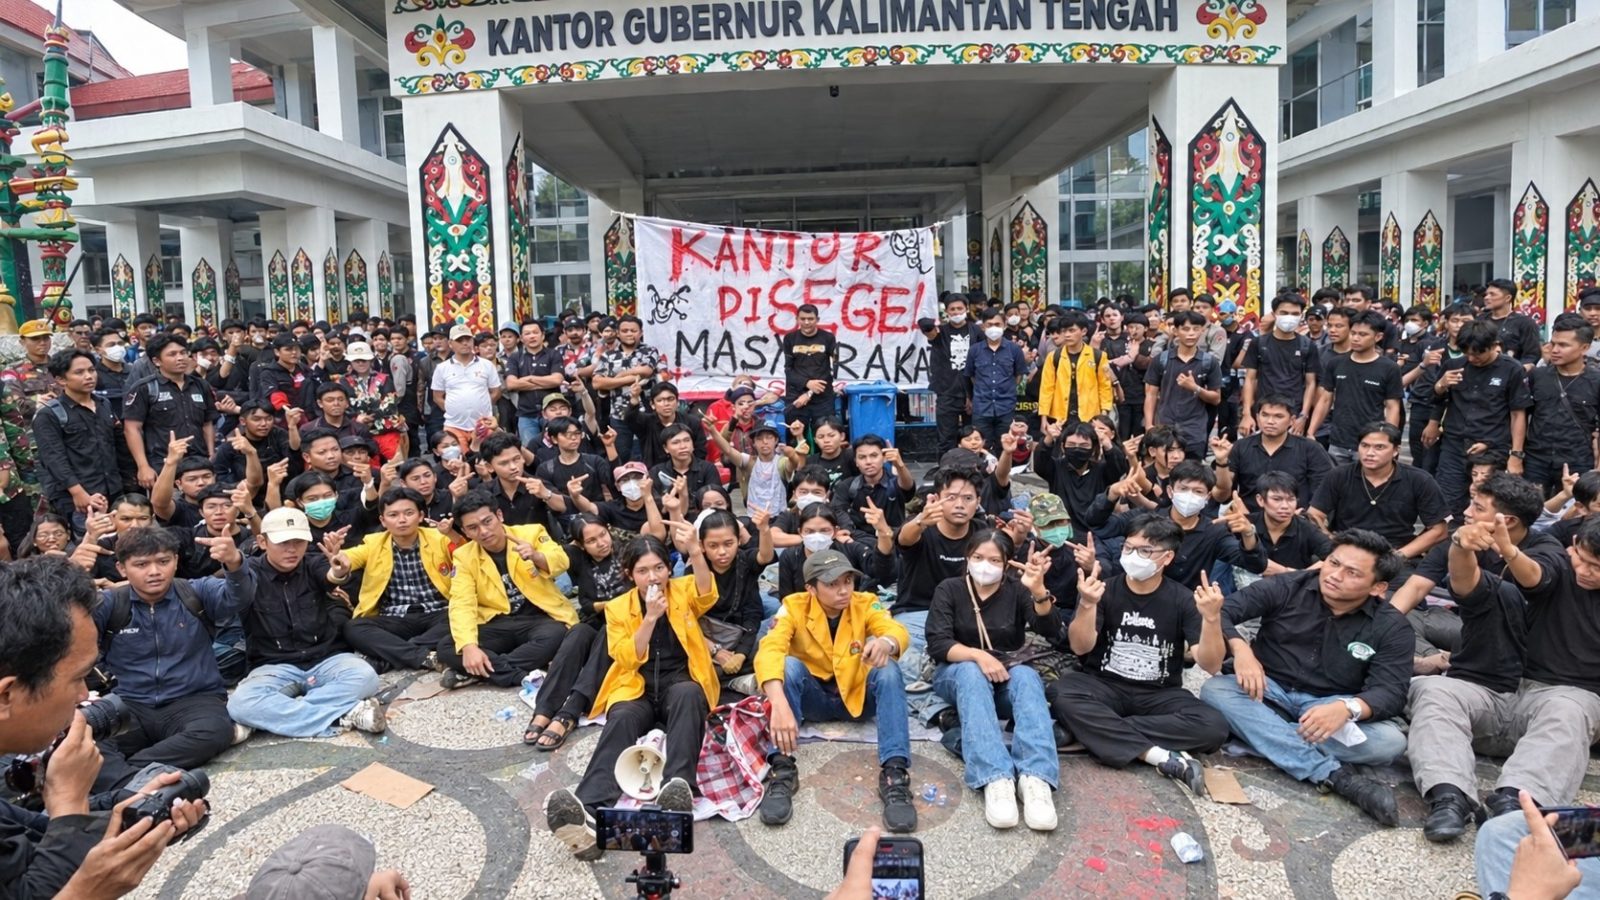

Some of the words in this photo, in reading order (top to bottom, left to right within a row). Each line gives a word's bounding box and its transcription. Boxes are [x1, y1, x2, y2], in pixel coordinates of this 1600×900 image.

[487, 11, 616, 56] KANTOR
[623, 0, 804, 45] GUBERNUR
[813, 0, 1032, 35] KALIMANTAN
[1040, 0, 1178, 32] TENGAH
[675, 329, 932, 384] MASYRAKA
